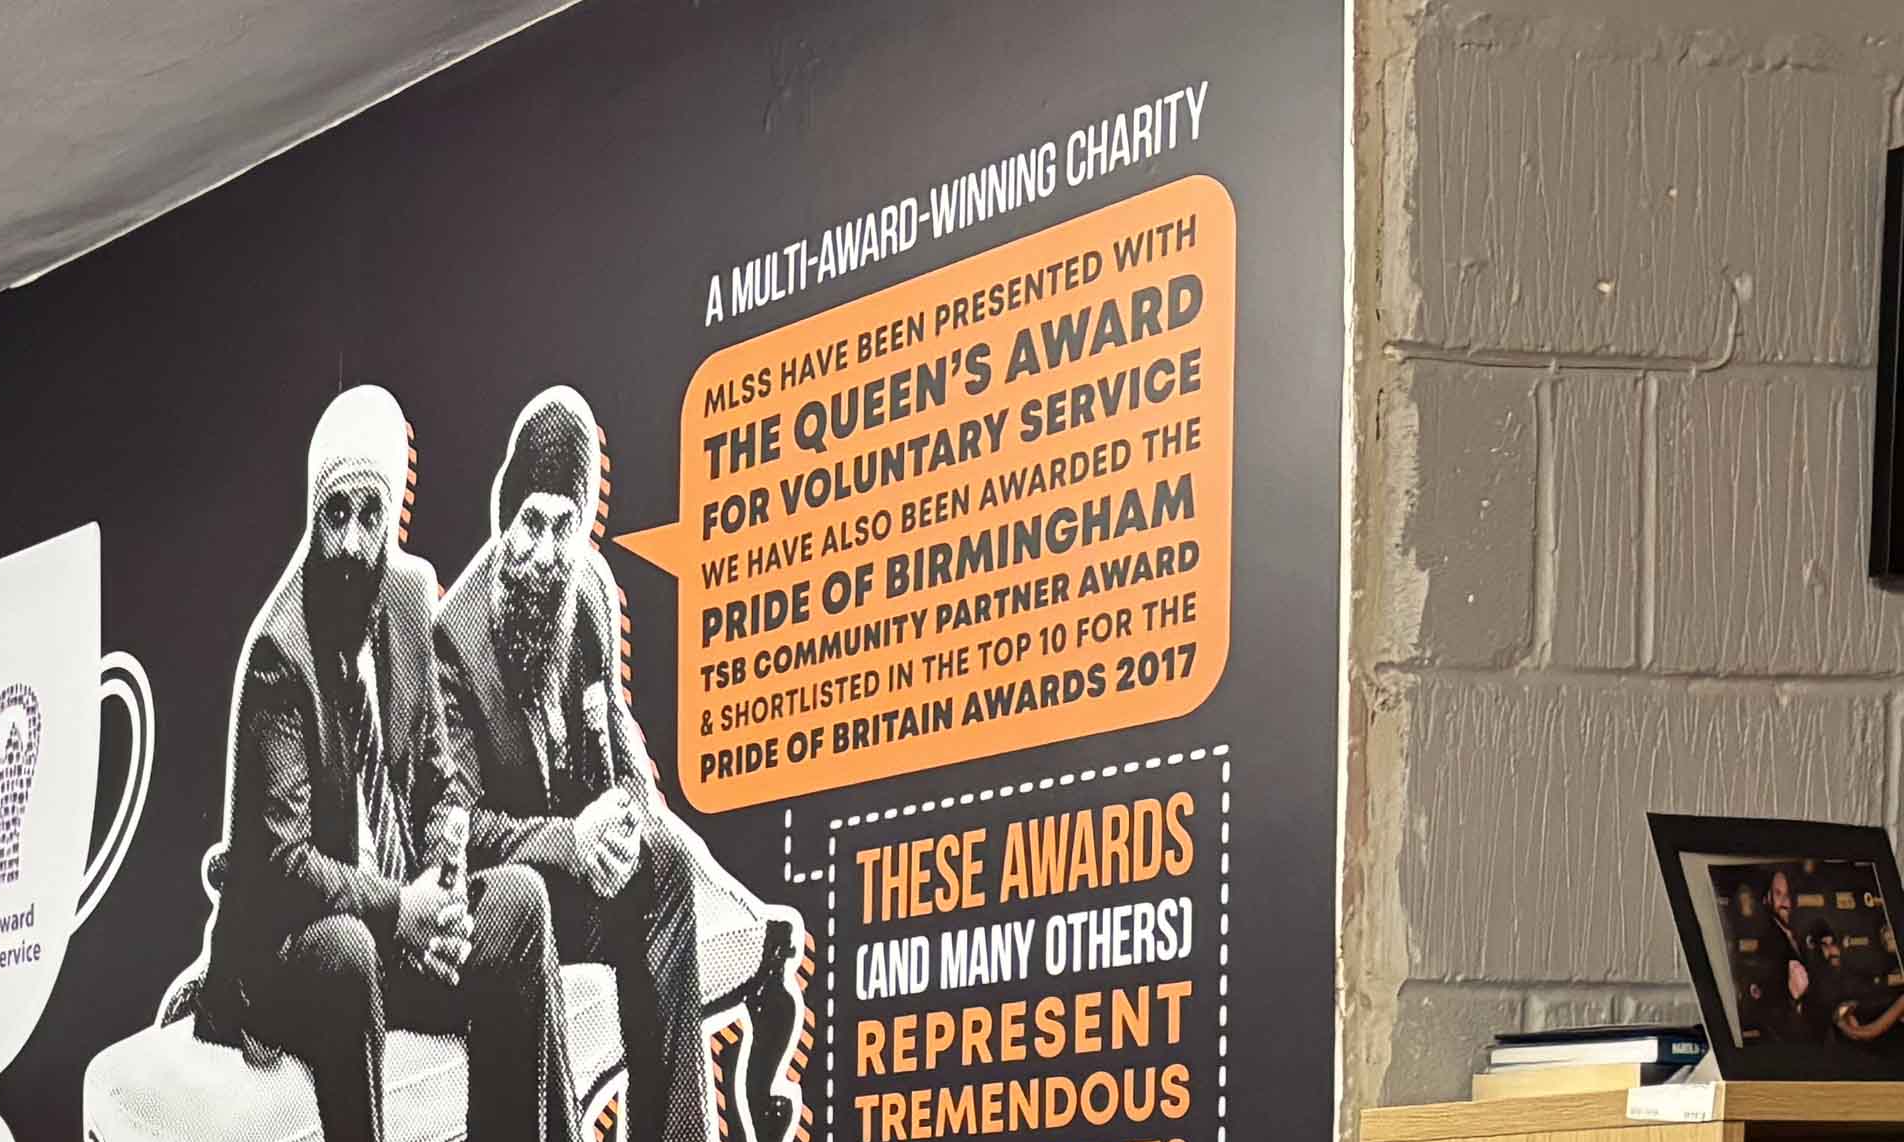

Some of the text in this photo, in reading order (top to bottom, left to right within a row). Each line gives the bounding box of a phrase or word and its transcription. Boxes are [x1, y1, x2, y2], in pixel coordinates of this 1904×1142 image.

[705, 81, 1208, 327] A MULTI-AWARD-WINNING CHARITY
[704, 214, 1196, 418] MLSS HAVE BEEN PRESENTED WITH
[704, 274, 1203, 480] THE QUEEN'S AWARD
[701, 417, 1200, 590] WE HAVE ALSO BEEN AWARDED THE
[703, 347, 1201, 541] FOR VOLUNTARY SERVICE
[700, 541, 1199, 692] TSB COMMUNITY PARTNER AWARD
[702, 473, 1194, 648] PRIDE OF BIRMINGHAM
[700, 592, 1196, 736] & SHORTLISTED IN THE TOP 10 FOR THE
[701, 642, 1196, 783] PRIDE OF BRITAIN AWARDS 2017
[856, 792, 1194, 924] THESE AWARDS
[856, 897, 1192, 1000] (AND MANY OTHERS)
[855, 1064, 1190, 1142] TREMENDOUS
[857, 981, 1192, 1077] REPRESENT
